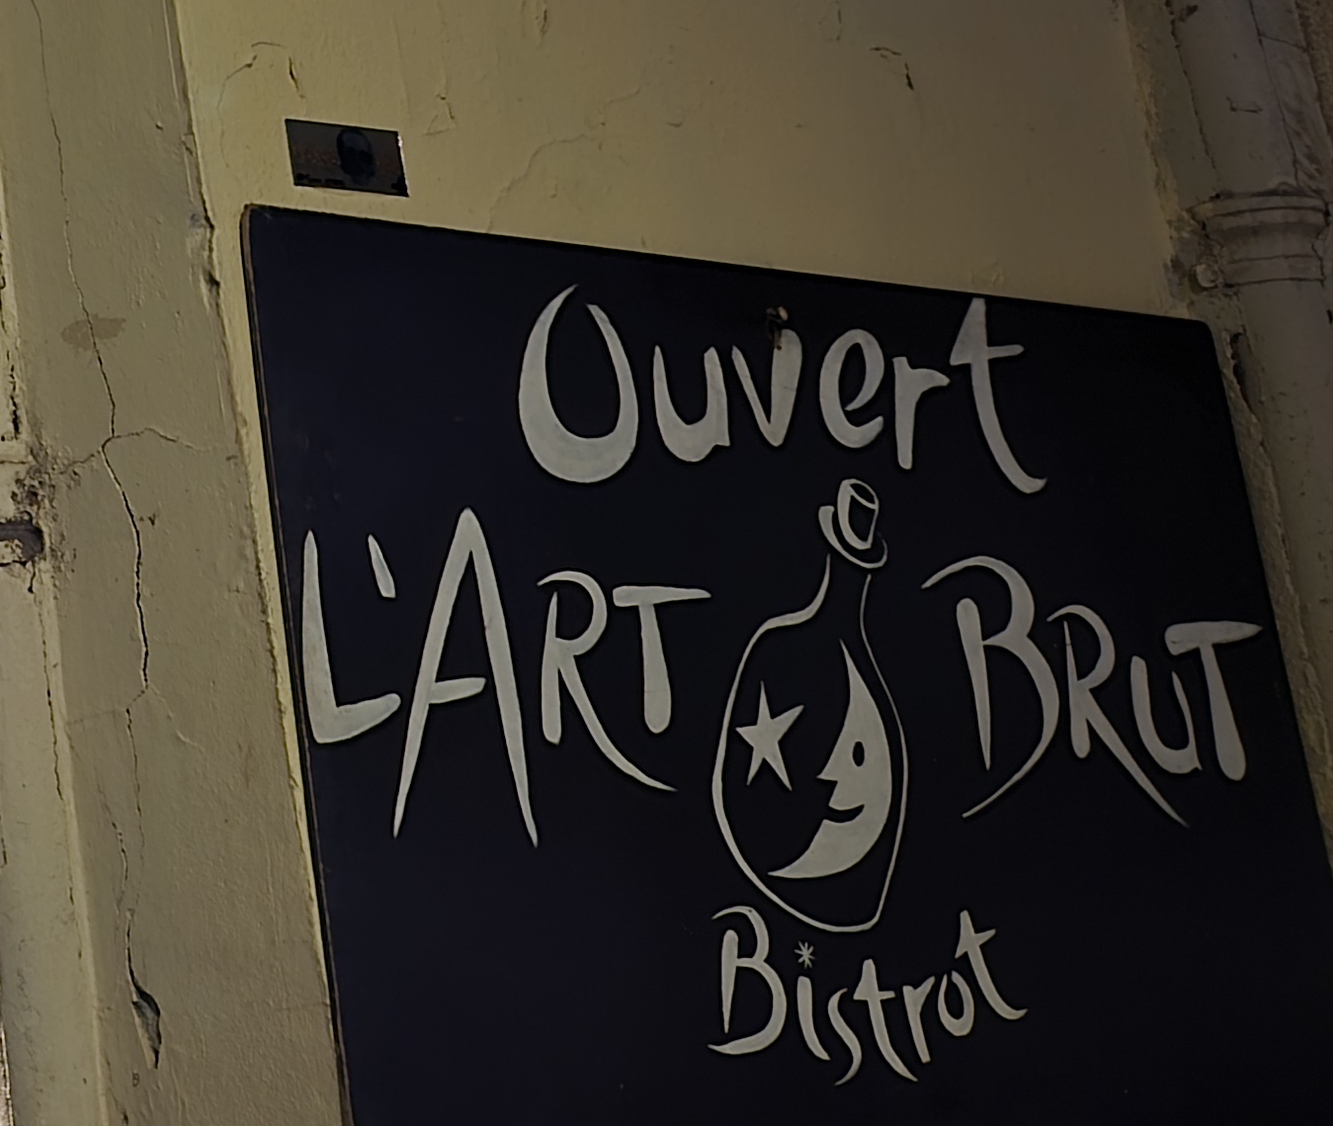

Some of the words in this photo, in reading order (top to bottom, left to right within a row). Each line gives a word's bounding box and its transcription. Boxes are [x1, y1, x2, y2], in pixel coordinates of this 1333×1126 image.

[517, 284, 1047, 493] Ouvert
[301, 507, 712, 848] L'ART
[921, 554, 1263, 828] BRUT
[708, 905, 1028, 1086] Bistrot
